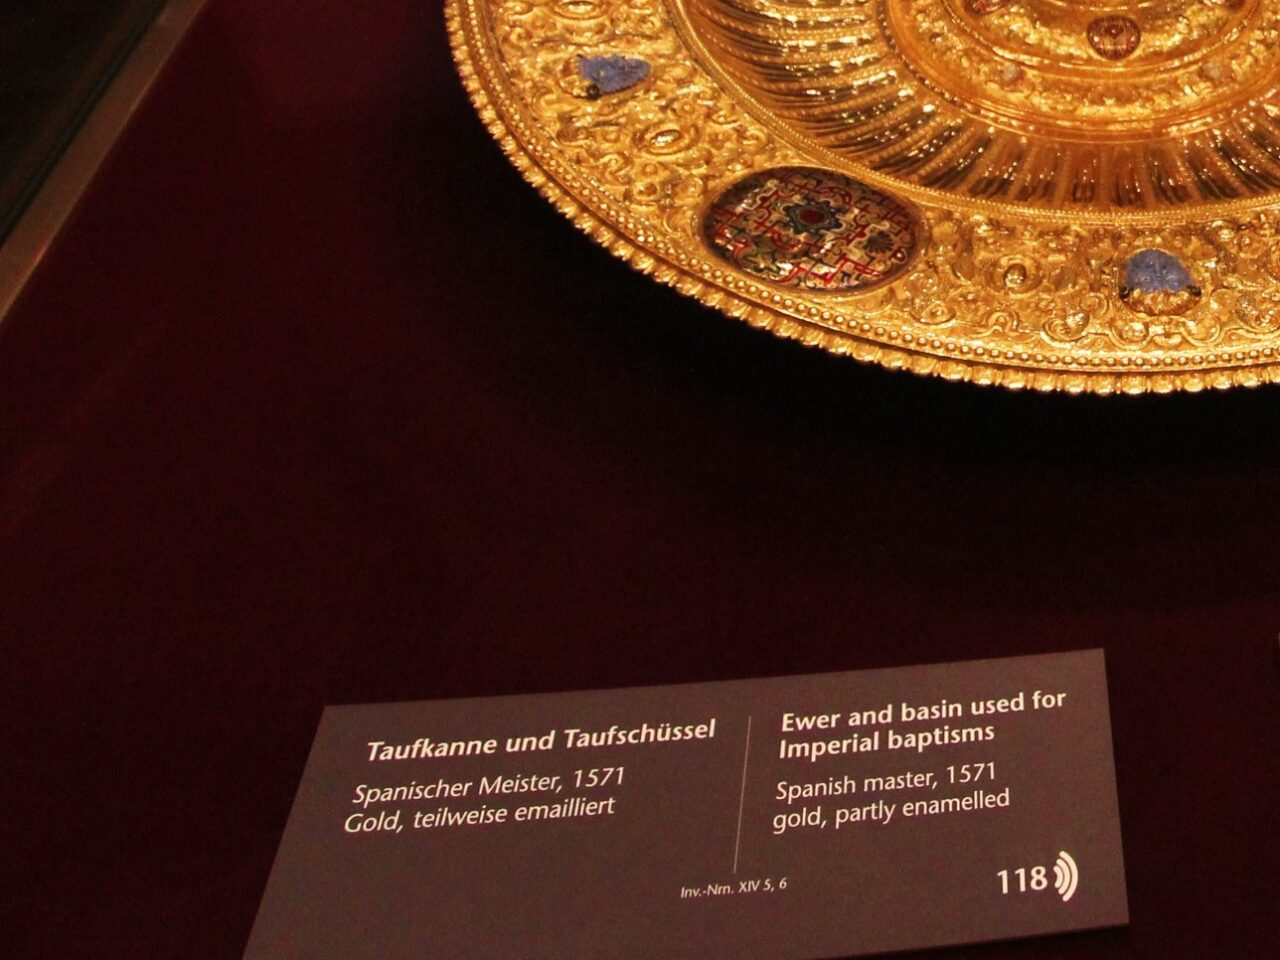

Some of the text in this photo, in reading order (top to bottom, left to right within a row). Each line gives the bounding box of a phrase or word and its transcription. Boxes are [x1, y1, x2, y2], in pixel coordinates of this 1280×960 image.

[782, 690, 1067, 732] Ewer and basin used for
[368, 718, 716, 761] Taufkanne und Taufschüssel
[780, 725, 995, 762] Imperial baptisms
[352, 767, 624, 808] Spanischer Meister, 1571
[776, 762, 994, 804] Spanish master, 1571
[344, 797, 616, 833] Gold, teilweise emailliert
[773, 787, 1009, 834] gold, partly enamelled
[681, 877, 787, 898] Inv.-Nrn. XIV 5, 6
[997, 866, 1048, 894] 118
